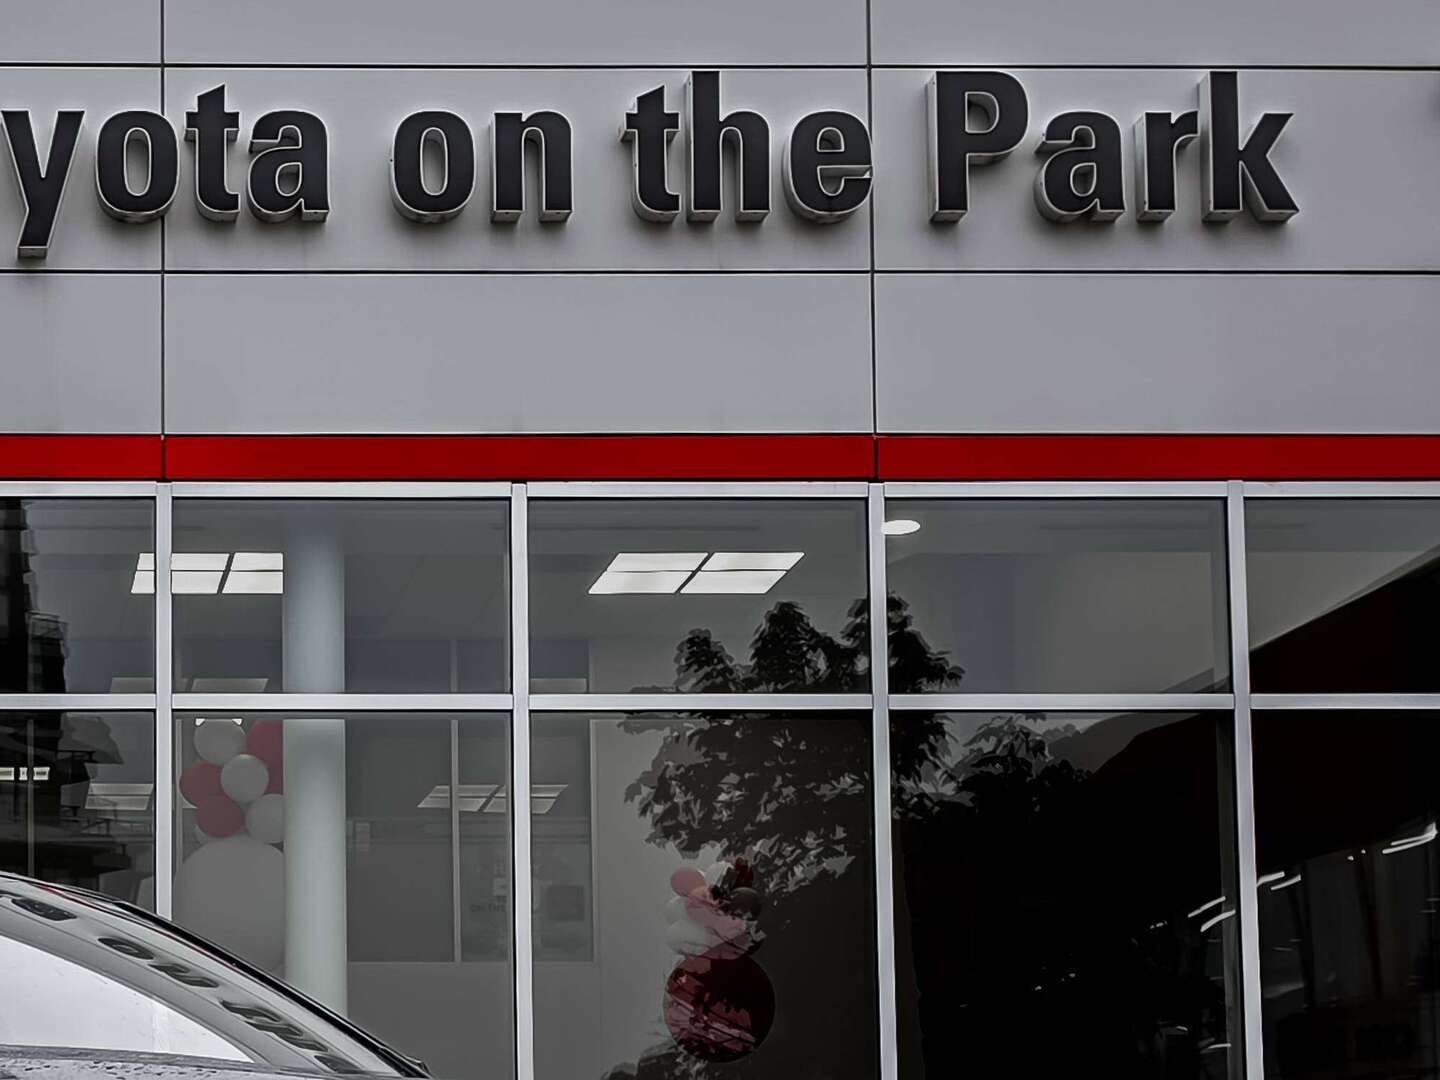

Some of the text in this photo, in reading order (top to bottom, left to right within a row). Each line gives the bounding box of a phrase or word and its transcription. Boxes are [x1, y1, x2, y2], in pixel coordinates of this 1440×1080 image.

[389, 110, 572, 223] on
[622, 70, 874, 223] the
[928, 70, 1299, 223] Park
